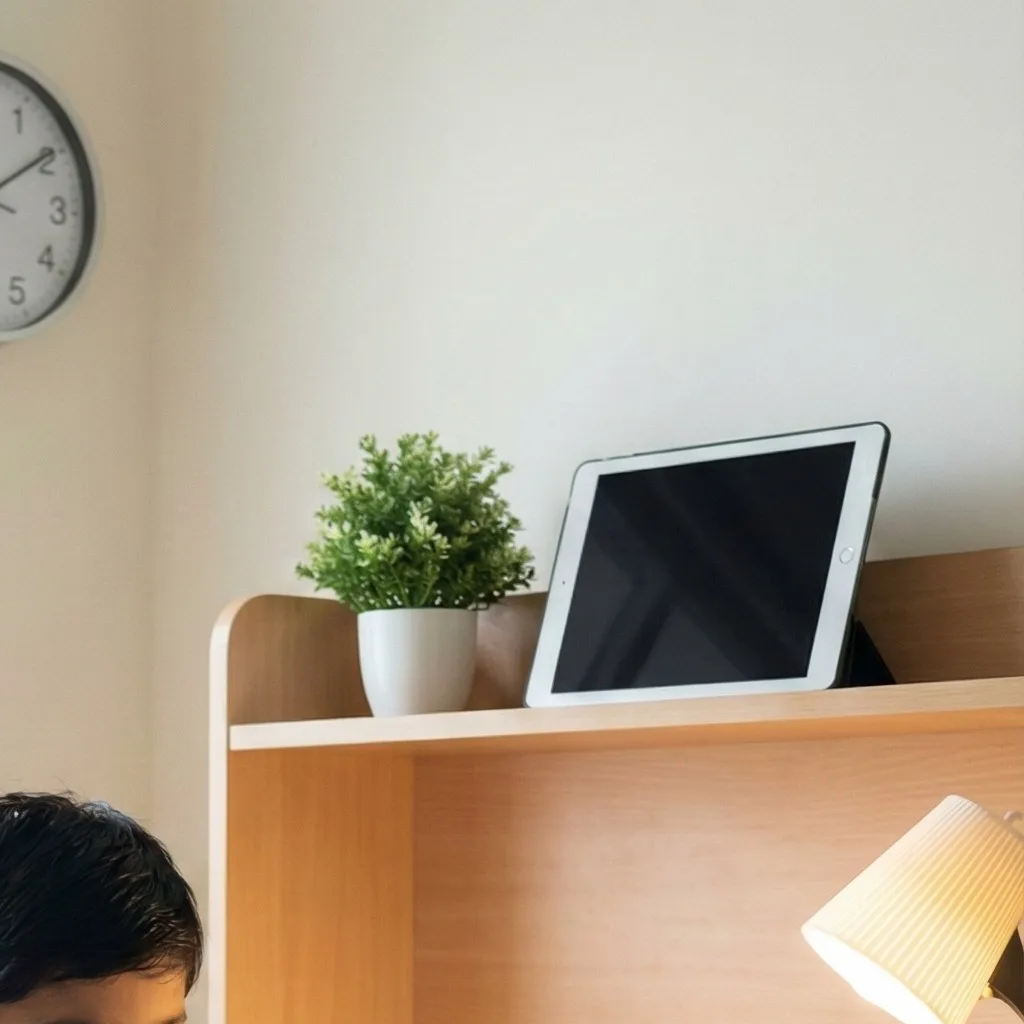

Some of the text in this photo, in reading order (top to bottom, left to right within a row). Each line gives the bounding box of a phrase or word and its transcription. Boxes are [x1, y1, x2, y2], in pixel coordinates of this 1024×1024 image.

[13, 106, 22, 135] 1
[38, 147, 56, 176] 2
[49, 196, 67, 226] 3
[37, 244, 55, 273] 4
[9, 276, 26, 306] 5
